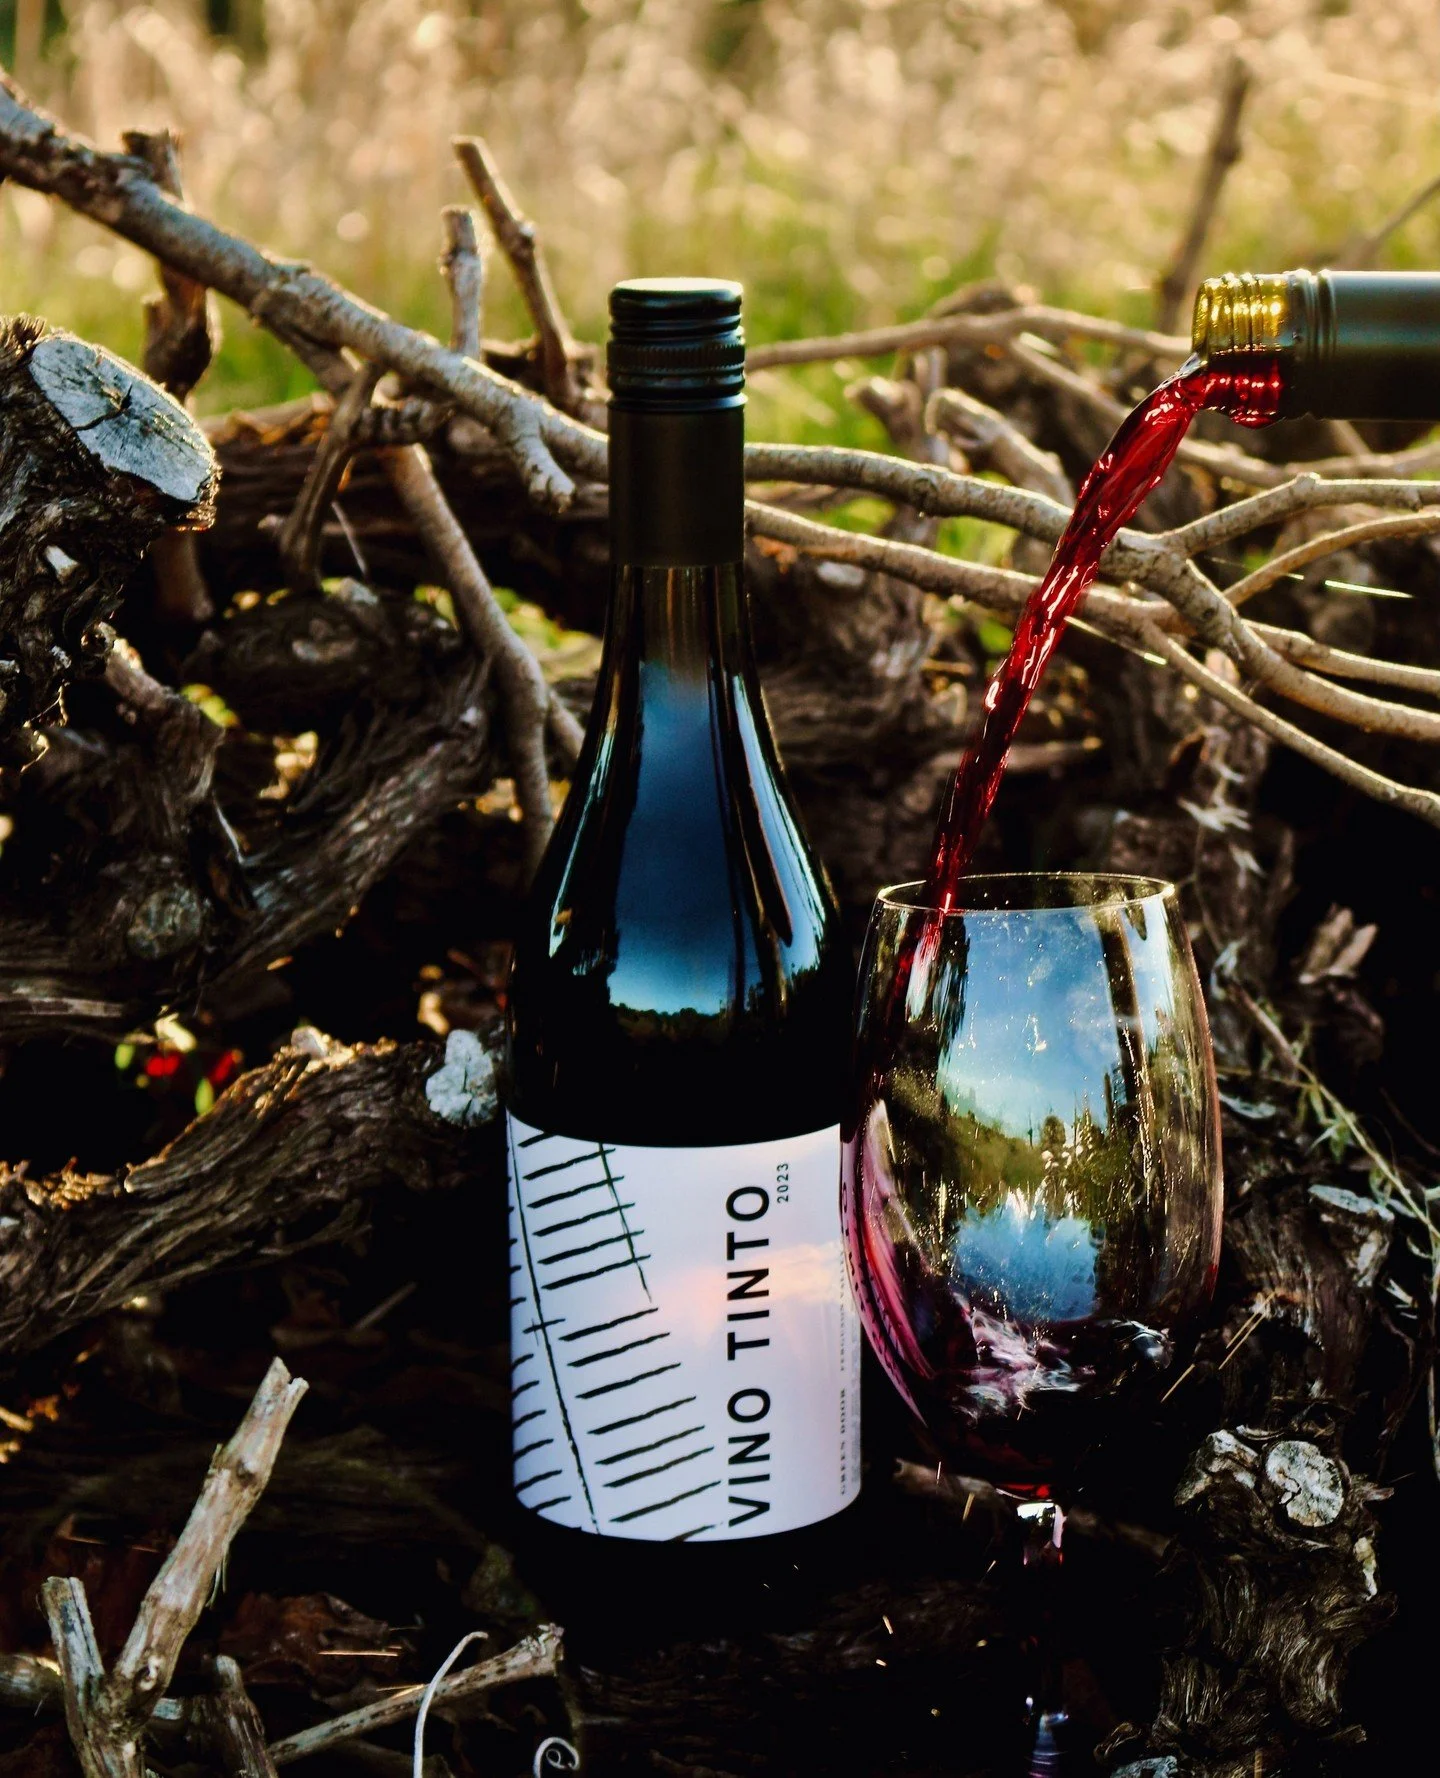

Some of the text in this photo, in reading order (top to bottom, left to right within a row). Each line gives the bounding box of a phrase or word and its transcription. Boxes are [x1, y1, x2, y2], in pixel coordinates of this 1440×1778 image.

[776, 1163, 789, 1203] 2023
[725, 1185, 771, 1527] VINO TINTO
[839, 1388, 847, 1434] DOOR
[839, 1441, 847, 1496] GREEN
